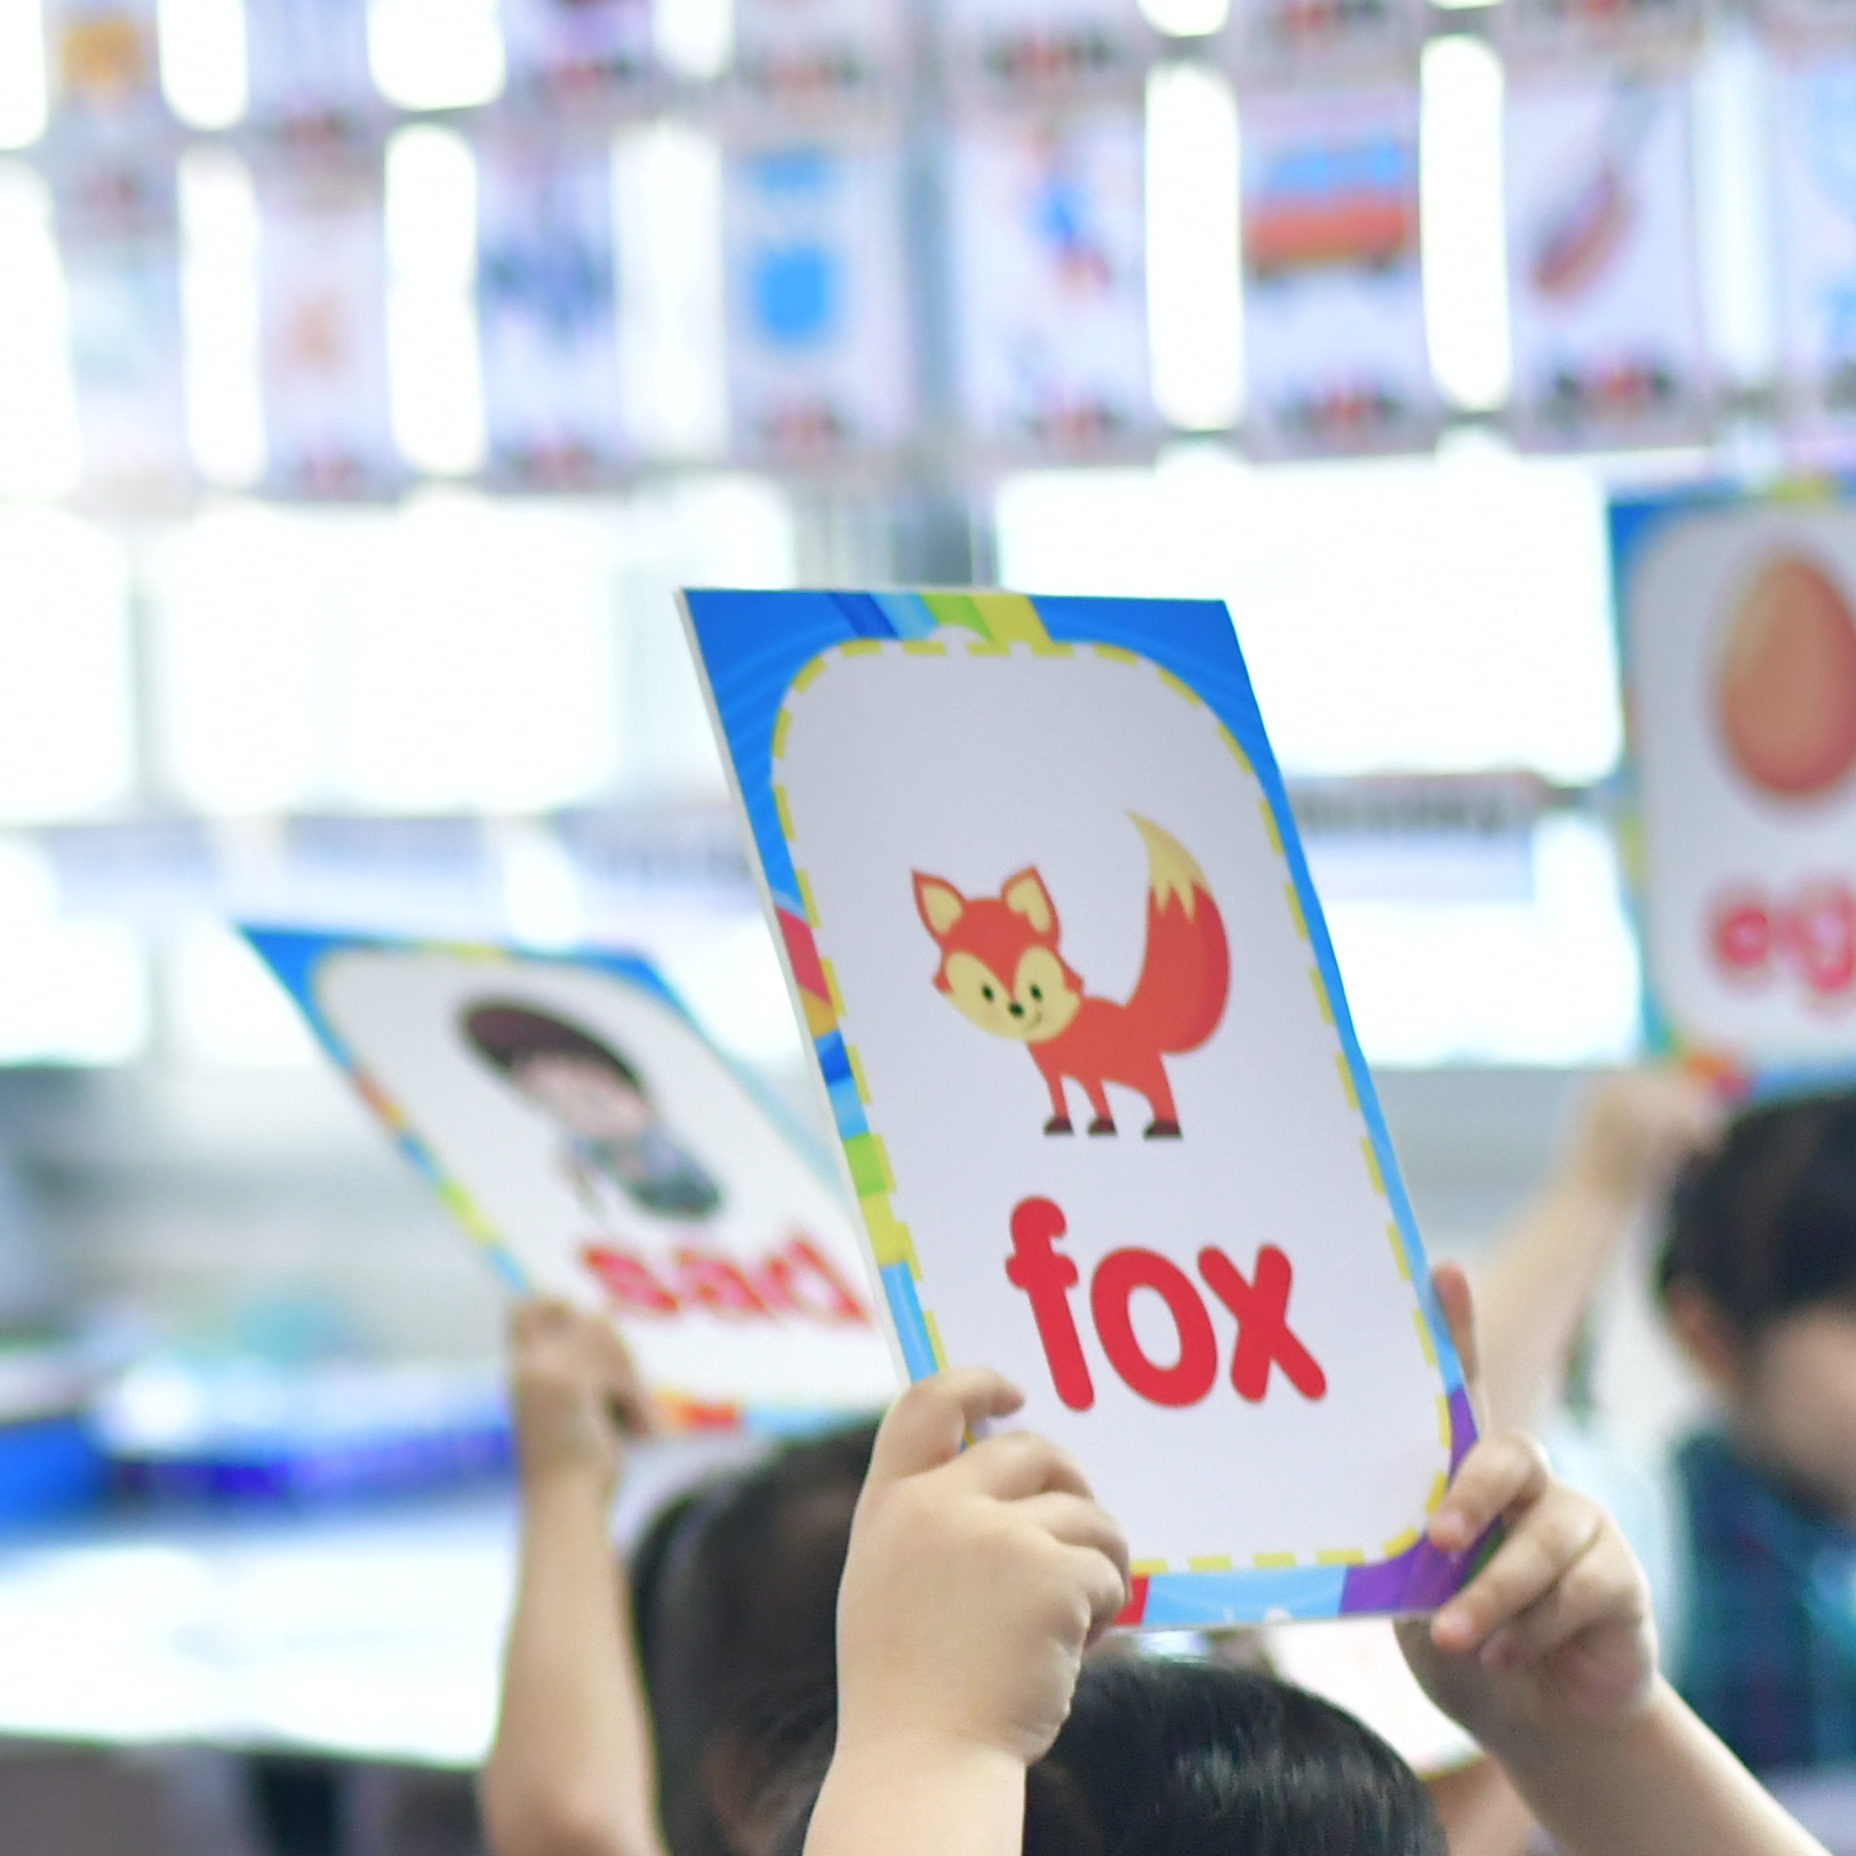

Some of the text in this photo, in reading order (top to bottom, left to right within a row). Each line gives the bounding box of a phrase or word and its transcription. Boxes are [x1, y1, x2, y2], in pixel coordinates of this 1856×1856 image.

[1713, 885, 1856, 1000] eg
[578, 1228, 873, 1328] sad
[1003, 1195, 1326, 1411] fox
